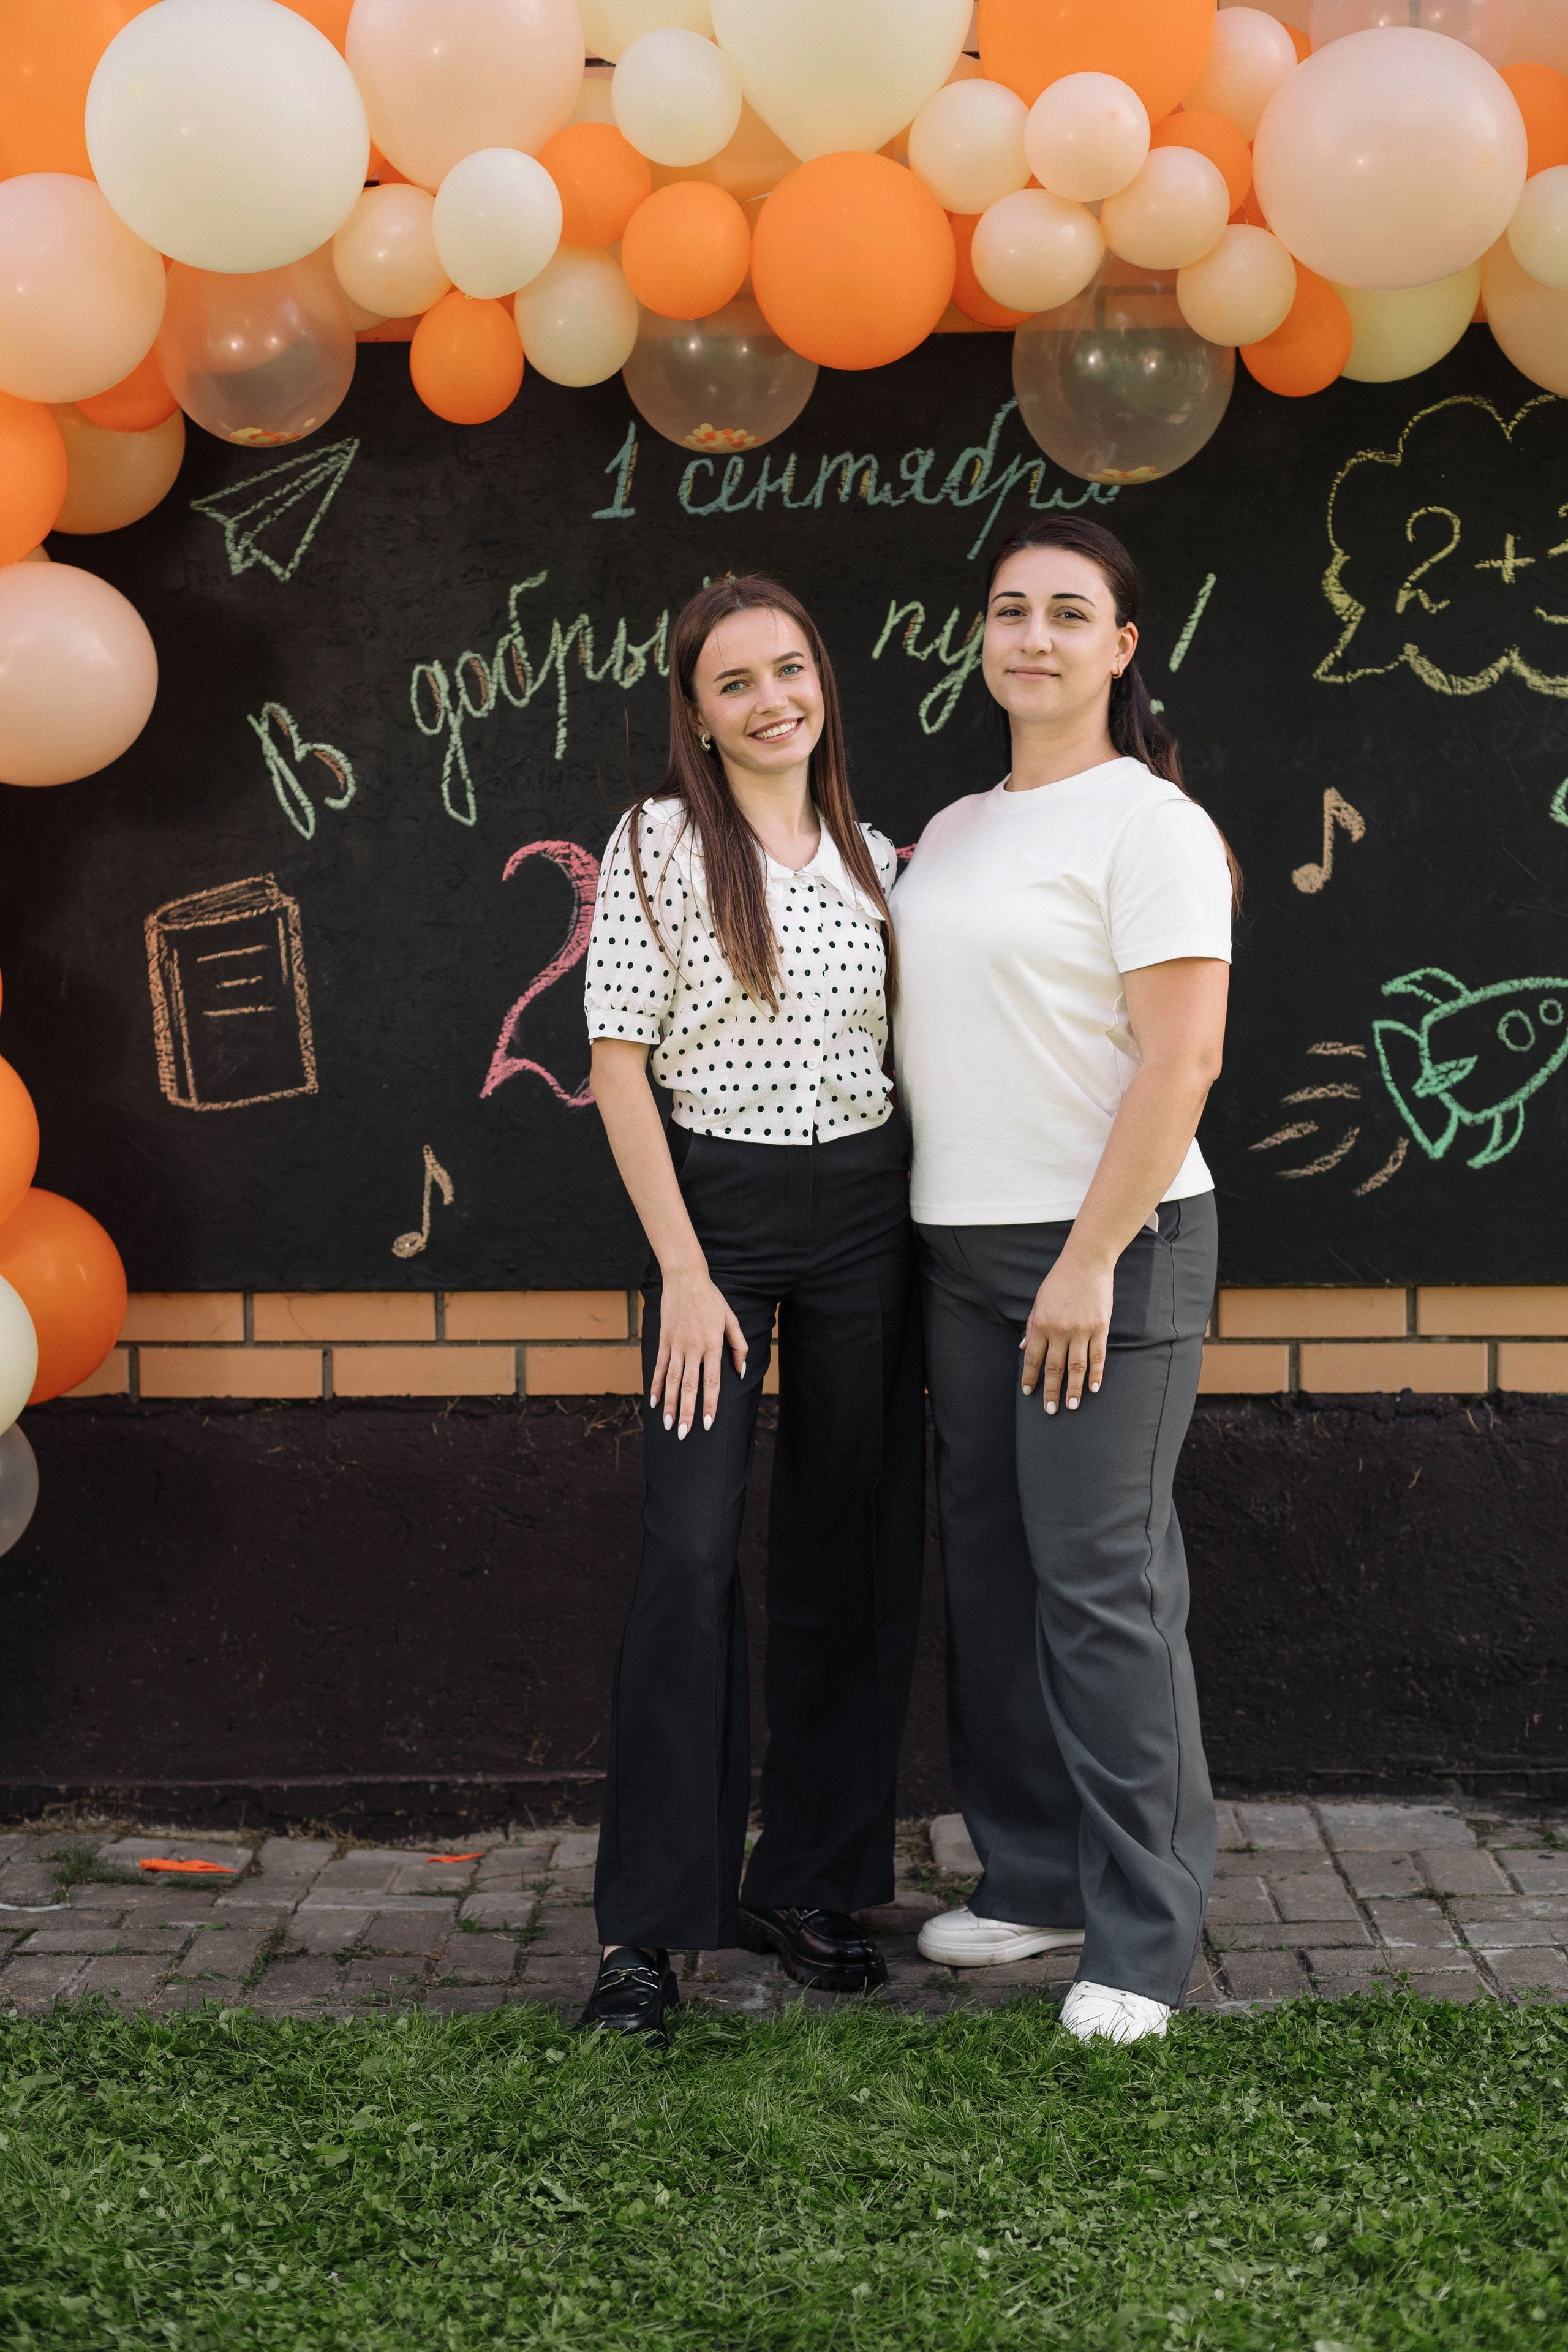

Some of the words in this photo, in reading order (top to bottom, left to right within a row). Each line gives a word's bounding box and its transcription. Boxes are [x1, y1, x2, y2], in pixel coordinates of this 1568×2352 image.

[592, 421, 639, 519] 1
[247, 702, 356, 840] В
[410, 570, 737, 827] добры
